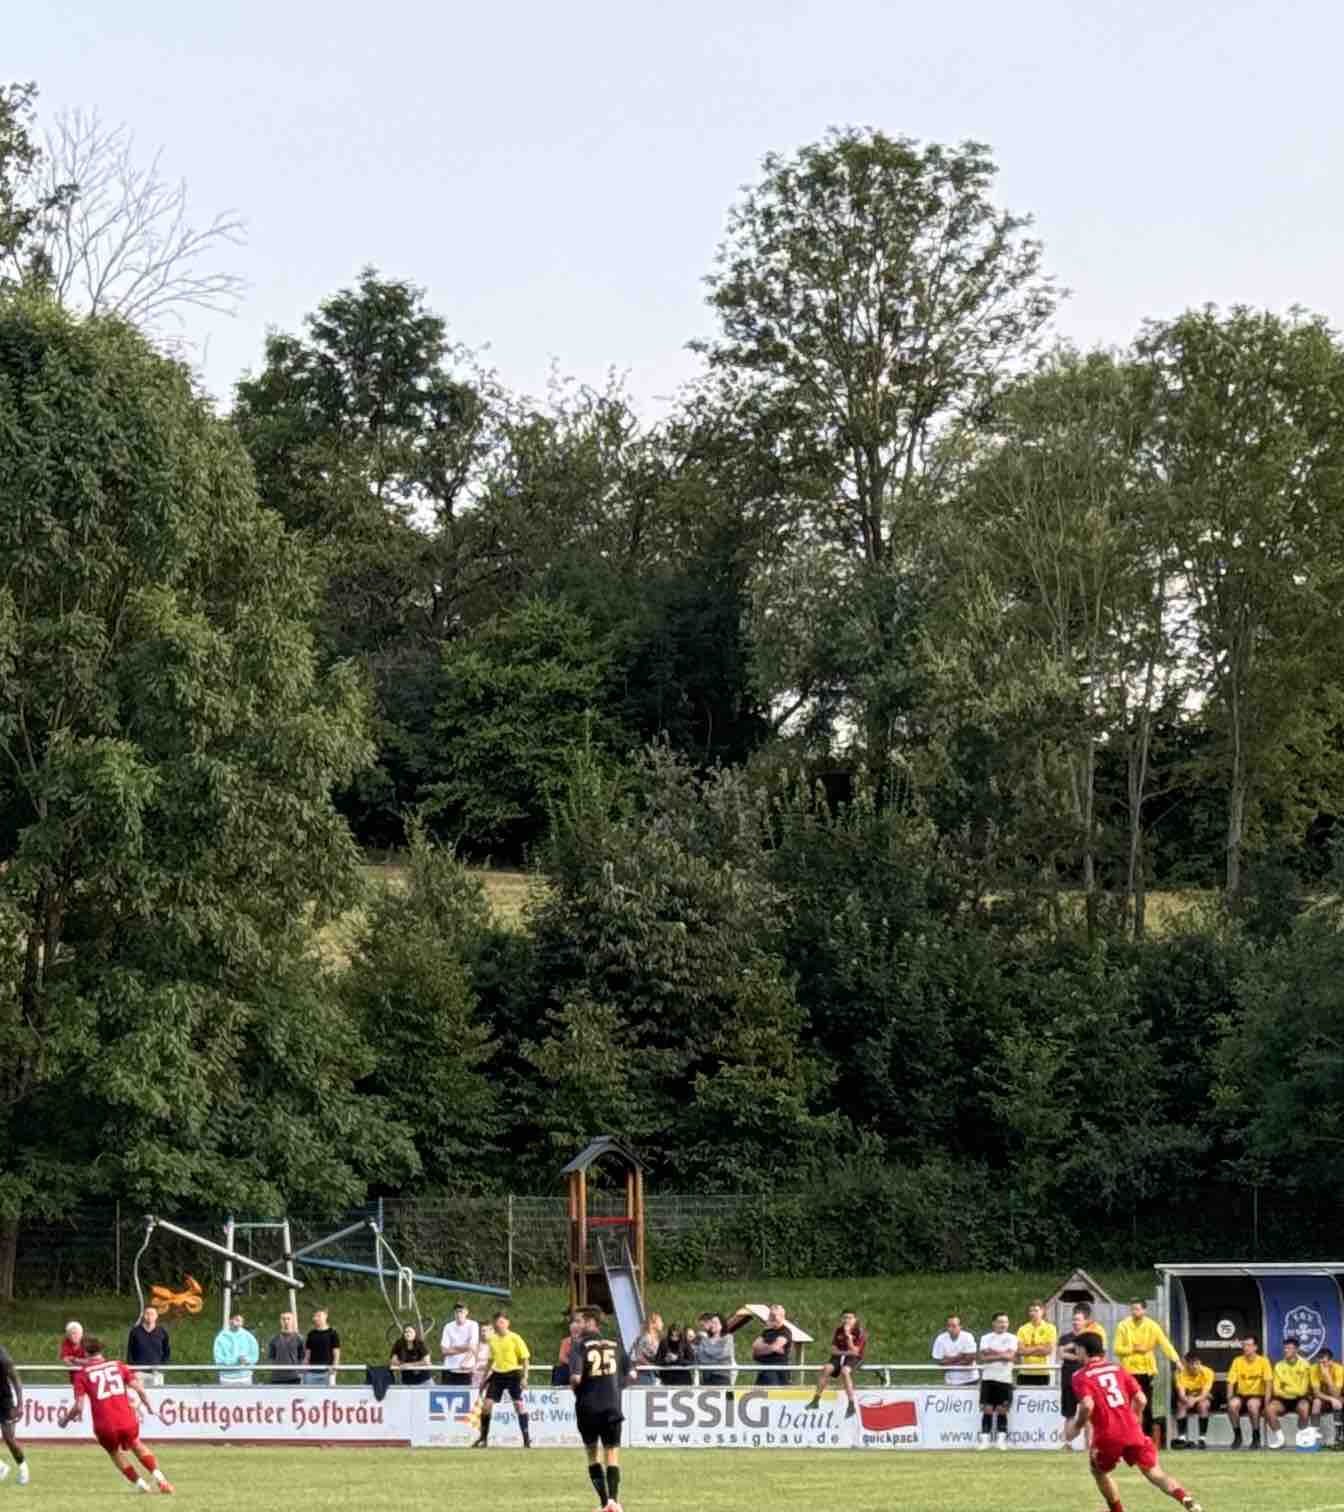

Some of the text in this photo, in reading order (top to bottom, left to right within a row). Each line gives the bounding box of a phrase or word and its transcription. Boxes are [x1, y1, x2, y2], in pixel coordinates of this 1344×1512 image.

[587, 1349, 618, 1377] 25
[88, 1367, 126, 1400] 25
[1097, 1372, 1126, 1409] 3
[159, 1397, 384, 1431] Stuttgarter Hofbräu
[645, 1390, 840, 1429] ESSIG baut.
[645, 1431, 840, 1447] www.essigbau.de
[862, 1433, 919, 1445] quickpack
